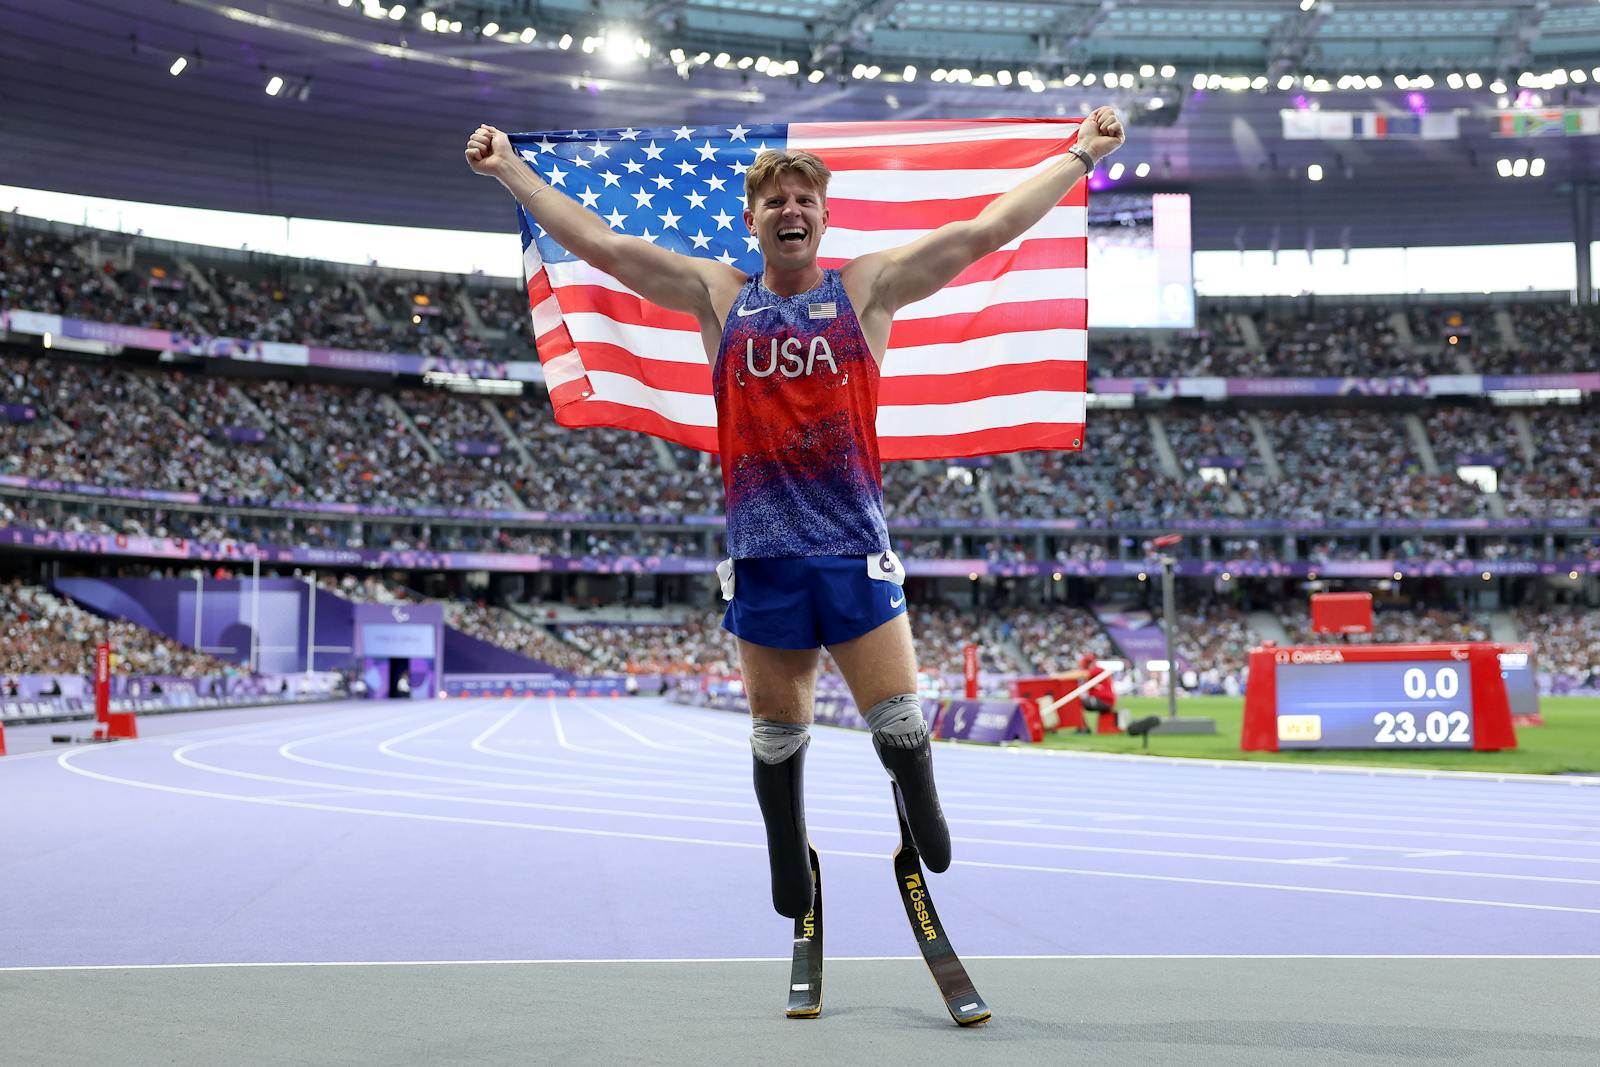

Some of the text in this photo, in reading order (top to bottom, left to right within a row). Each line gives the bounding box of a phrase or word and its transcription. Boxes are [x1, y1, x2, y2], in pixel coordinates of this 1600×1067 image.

[746, 336, 838, 378] USA
[1403, 668, 1459, 699] 0.0
[1374, 711, 1471, 743] 23.02
